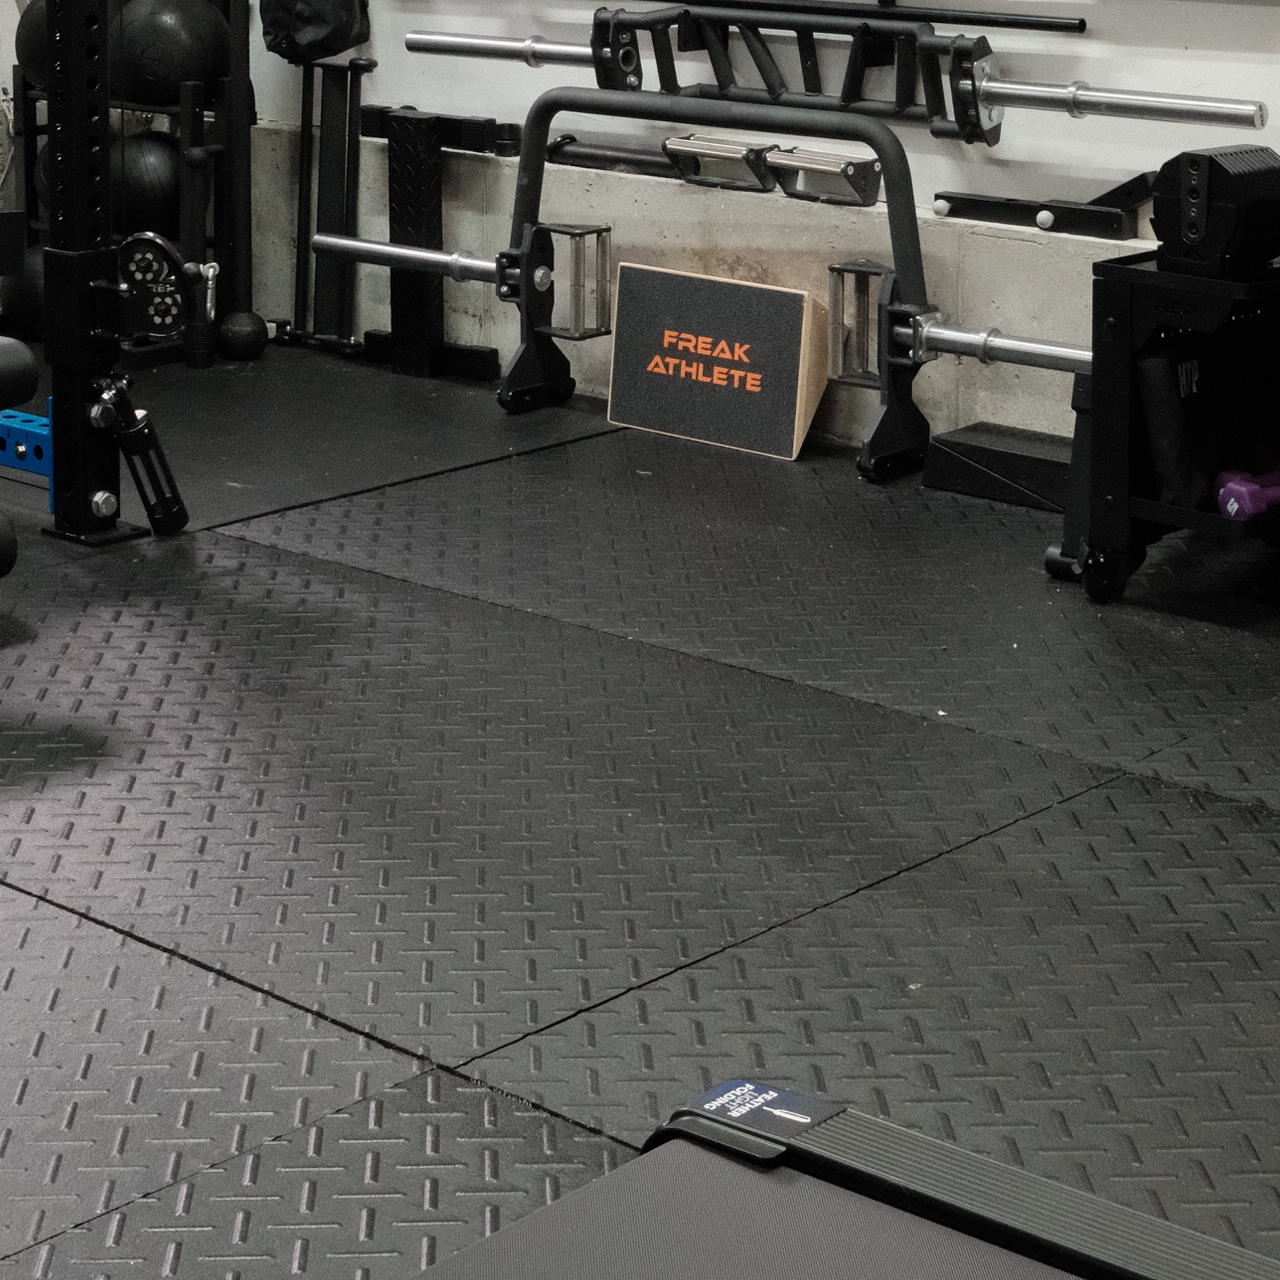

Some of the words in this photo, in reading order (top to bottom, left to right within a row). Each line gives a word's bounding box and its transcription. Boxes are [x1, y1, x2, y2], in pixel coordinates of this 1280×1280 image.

[662, 329, 751, 365] FREAK
[646, 355, 763, 393] ATHLETE
[704, 1083, 756, 1110] FOLDING
[725, 1090, 759, 1110] LIGHT
[727, 1090, 779, 1117] FEATHER
